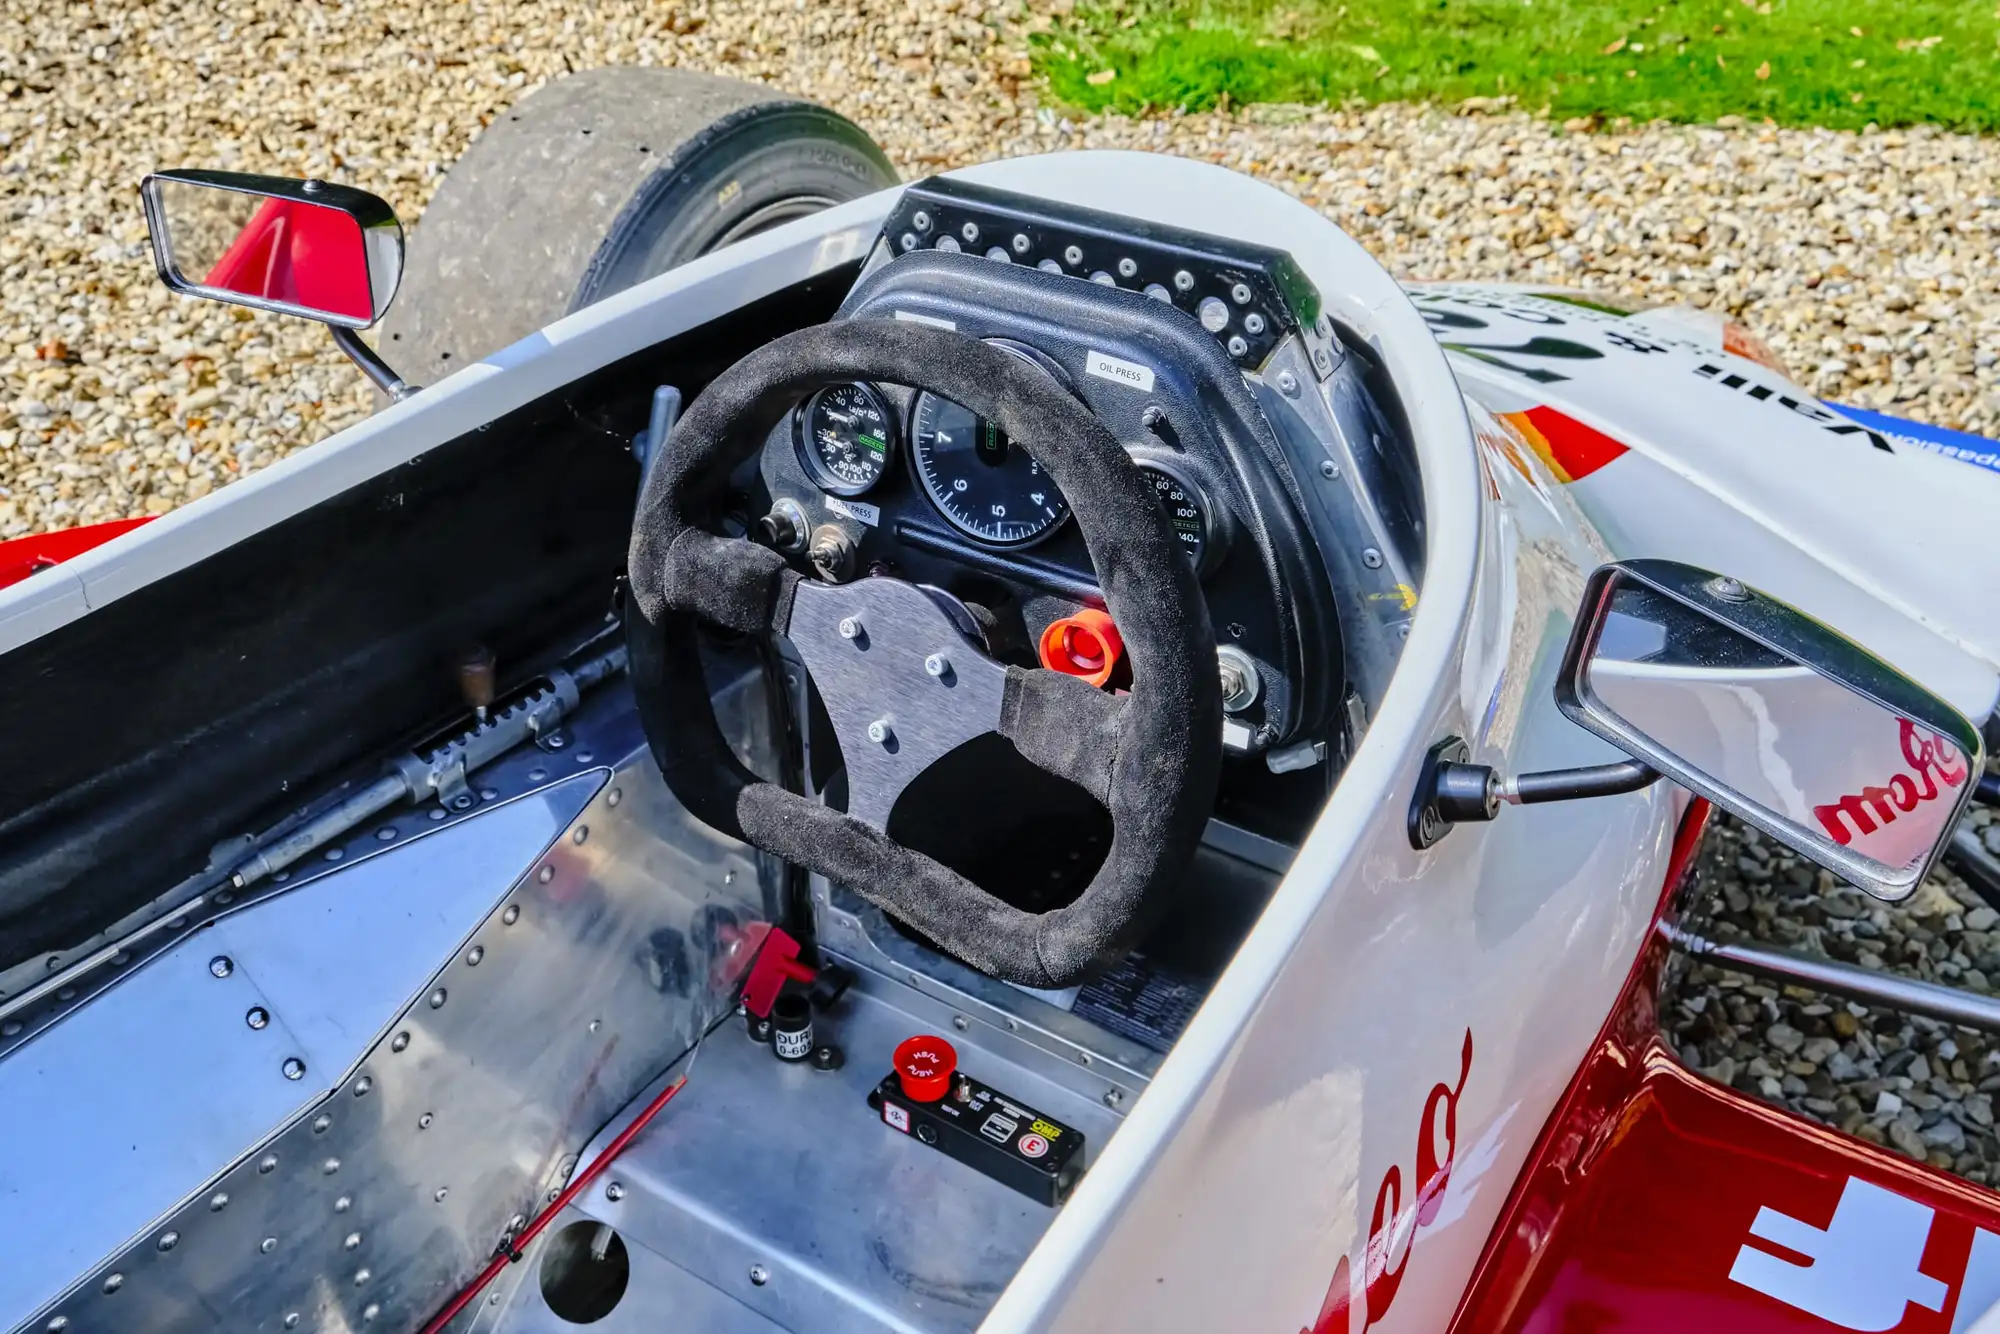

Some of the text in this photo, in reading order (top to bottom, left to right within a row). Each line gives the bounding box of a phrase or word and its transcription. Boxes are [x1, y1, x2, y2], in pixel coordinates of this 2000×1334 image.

[1099, 362, 1141, 382] OIL PRESS
[835, 397, 846, 407] 40
[937, 431, 952, 444] 7
[849, 463, 862, 475] 100
[953, 479, 968, 492] 6
[1156, 481, 1169, 490] 60
[1030, 492, 1045, 506] 4
[1170, 491, 1183, 501] 80
[850, 505, 872, 519] PRESS
[991, 504, 1006, 517] 5
[1176, 508, 1194, 518] 100
[913, 1050, 940, 1064] PUSH
[907, 1064, 934, 1078] PUSH
[1031, 1119, 1061, 1140] OMP
[1026, 1139, 1041, 1152] E
